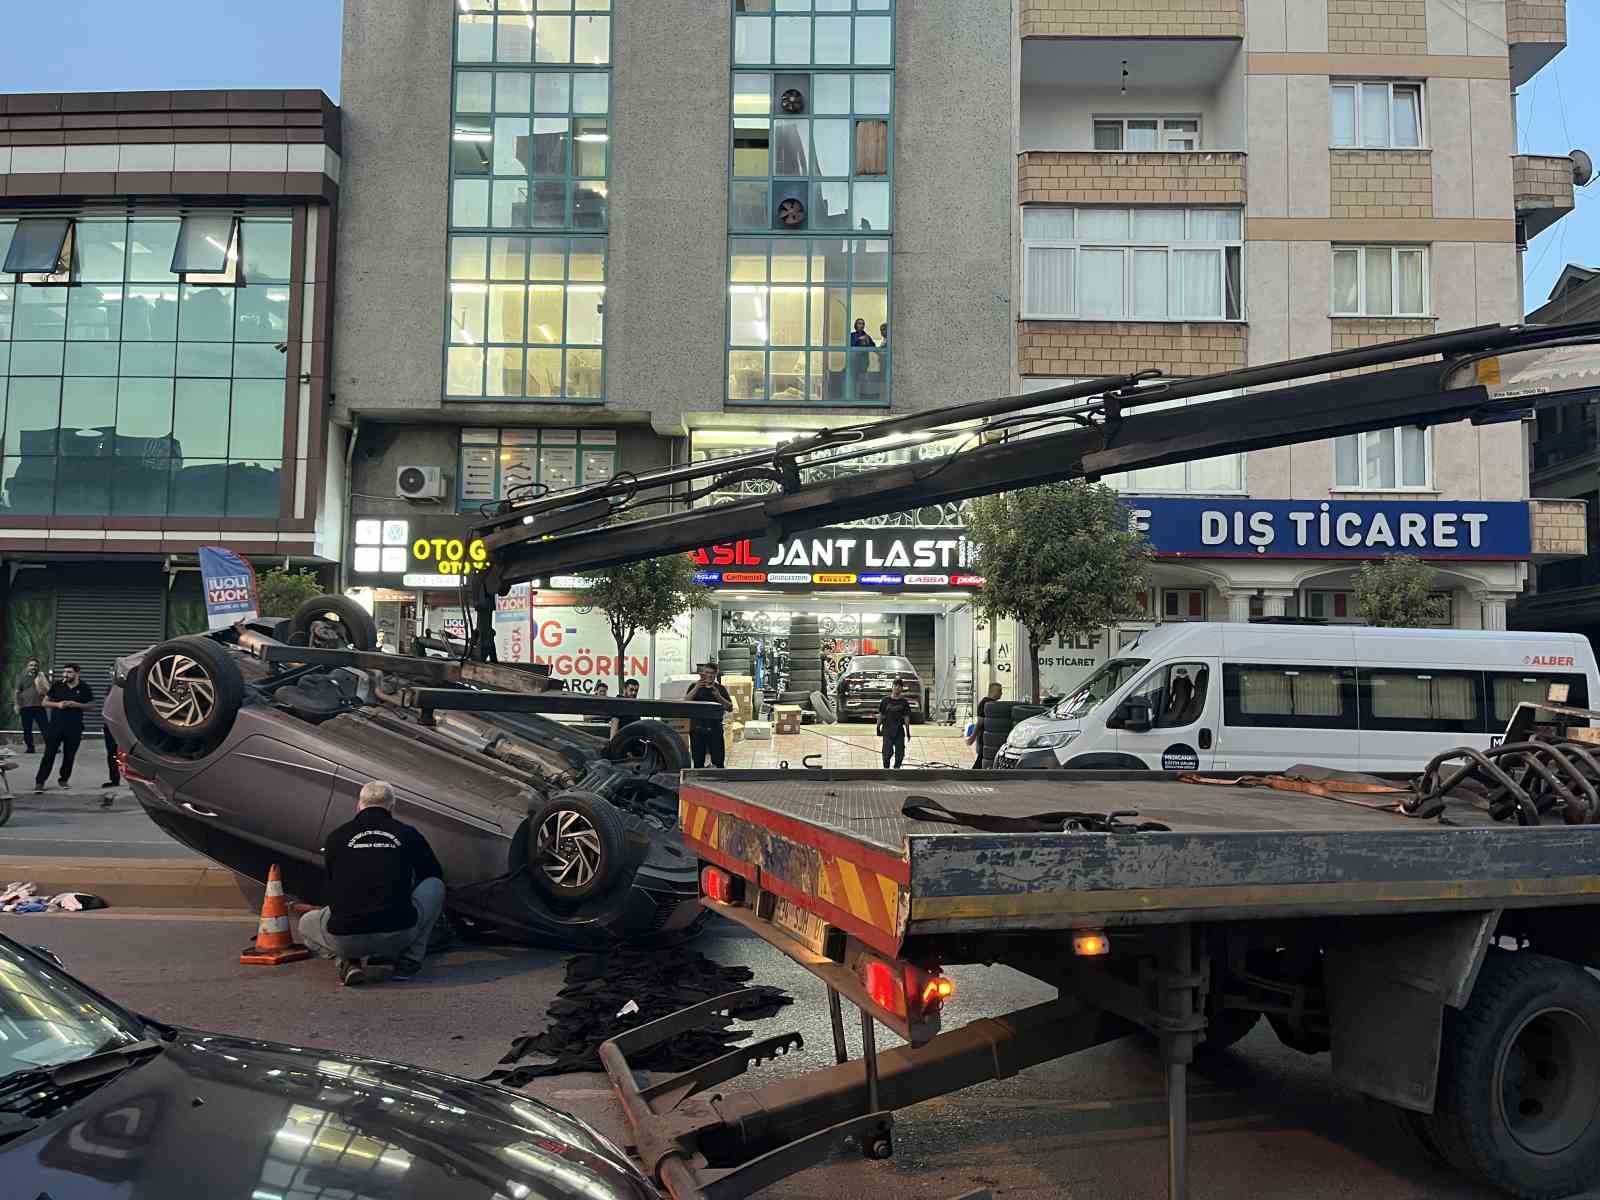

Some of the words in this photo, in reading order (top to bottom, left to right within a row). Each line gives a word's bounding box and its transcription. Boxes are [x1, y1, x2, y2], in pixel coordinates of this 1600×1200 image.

[1202, 511, 1275, 553] DIŞ
[1289, 503, 1488, 547] TİCARET
[413, 539, 463, 561] OTO
[768, 539, 857, 567] JANT
[534, 648, 649, 677] NGÖREN
[1056, 655, 1095, 667] TİCARET
[1531, 656, 1574, 666] ALBER
[560, 678, 602, 694] ARÇA
